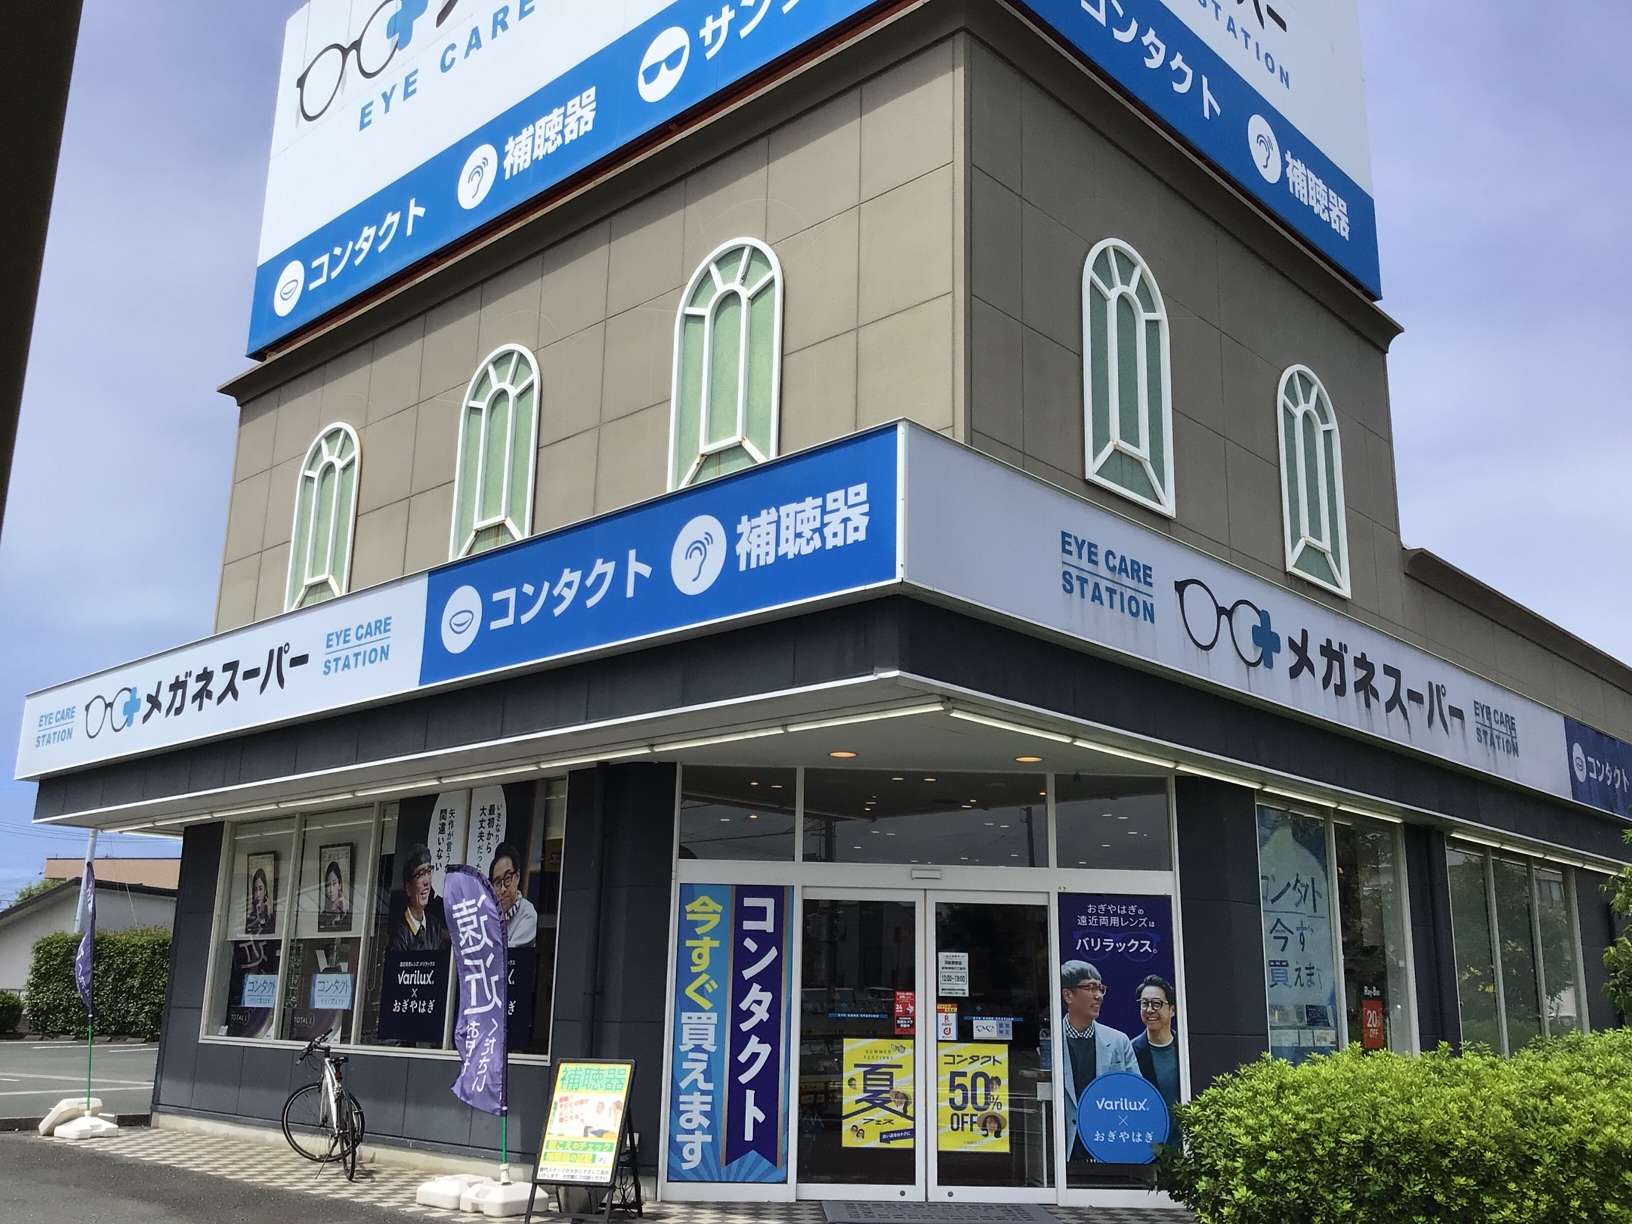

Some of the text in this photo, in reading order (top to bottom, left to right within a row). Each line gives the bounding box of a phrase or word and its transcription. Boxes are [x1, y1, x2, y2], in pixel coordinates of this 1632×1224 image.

[359, 70, 418, 132] EYE
[440, 0, 536, 74] CARE
[503, 86, 597, 181] 補聴器
[1285, 150, 1350, 242] 補聴器
[308, 199, 426, 291] コンタクト
[735, 482, 870, 571] 補聴器
[1060, 529, 1153, 588] EYE CARE
[490, 548, 652, 631] コンタクト
[1061, 570, 1155, 624] STATION
[325, 616, 392, 649] EYE CARE
[322, 644, 390, 676] STATION
[142, 642, 310, 725] メガネスーパー
[1288, 628, 1465, 735] メガネスーパー
[38, 706, 76, 728] EYE CARE
[1474, 700, 1516, 732] EYE CARE
[35, 727, 73, 748] STATION
[1476, 727, 1519, 759] STATION
[1587, 756, 1630, 793] コンタクト
[435, 808, 448, 872] 間違いない
[486, 803, 496, 854] 最初から
[1077, 915, 1155, 928] 遠近両用レンズは
[1087, 904, 1144, 915] おぎやはぎの
[318, 979, 350, 995] コンタクト
[393, 1000, 435, 1014] おぎやはぎ
[737, 897, 778, 1142] コンタクト
[675, 895, 724, 1170] 今すぐ買えます
[943, 1054, 1003, 1066] コンタクト
[560, 1066, 627, 1092] 補聴器
[950, 1113, 978, 1132] OFF
[1093, 1131, 1154, 1143] おぎやはぎ
